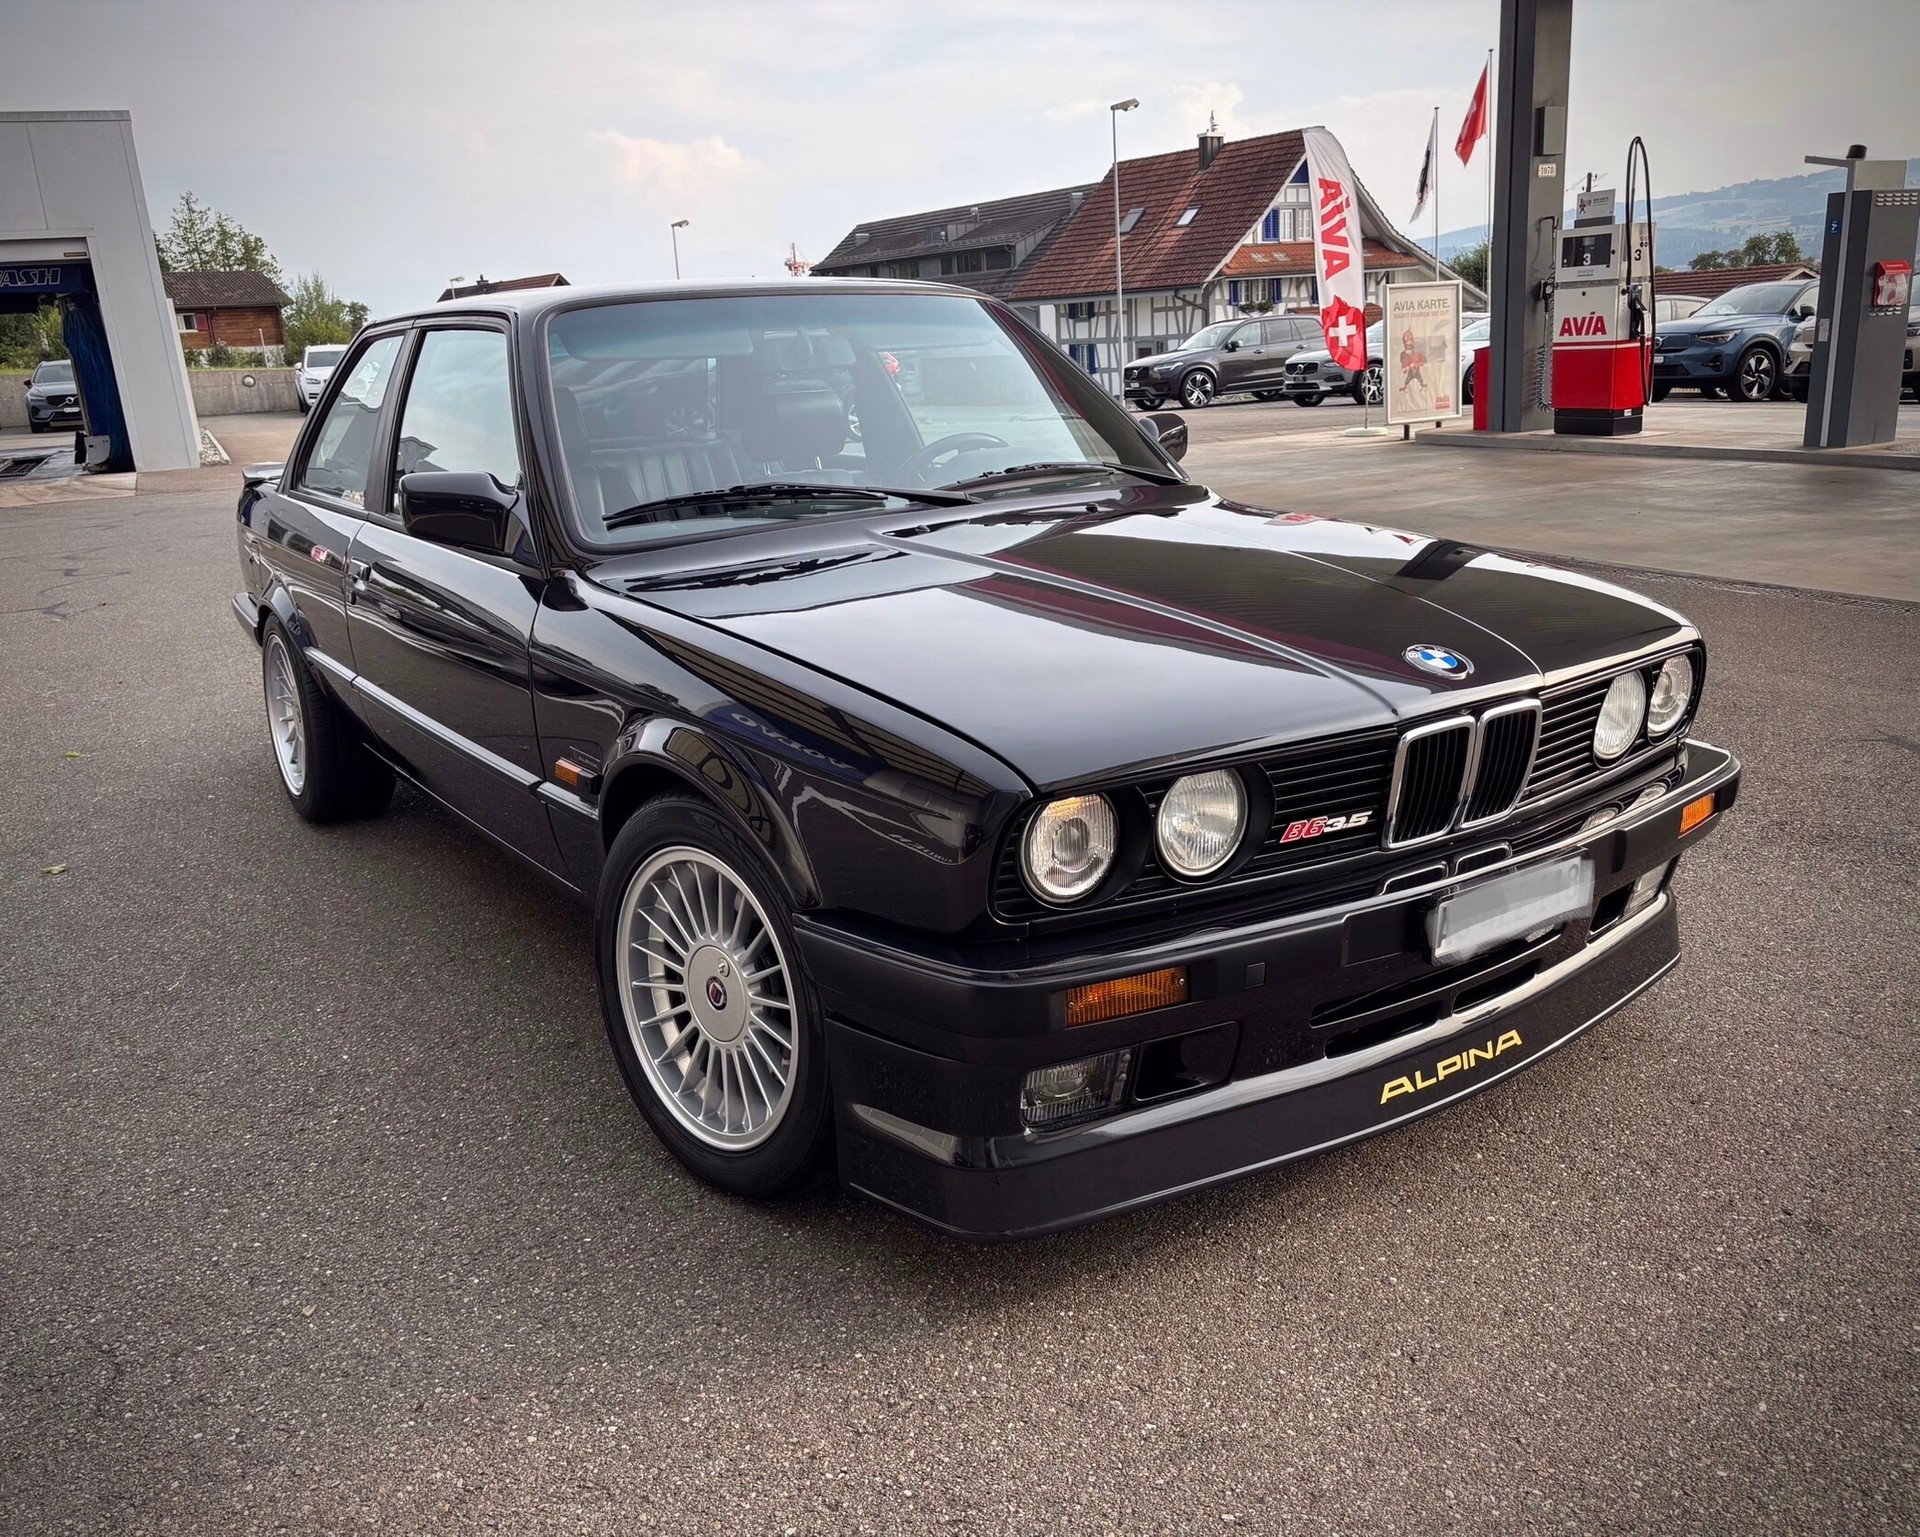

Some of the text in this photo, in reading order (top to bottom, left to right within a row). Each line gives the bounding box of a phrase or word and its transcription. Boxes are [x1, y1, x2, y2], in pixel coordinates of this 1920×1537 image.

[1583, 253, 1591, 265] 3
[1634, 249, 1641, 261] 3
[0, 267, 61, 287] ASH
[1393, 301, 1415, 311] AVIA
[1380, 1029, 1523, 1105] ALPINA
